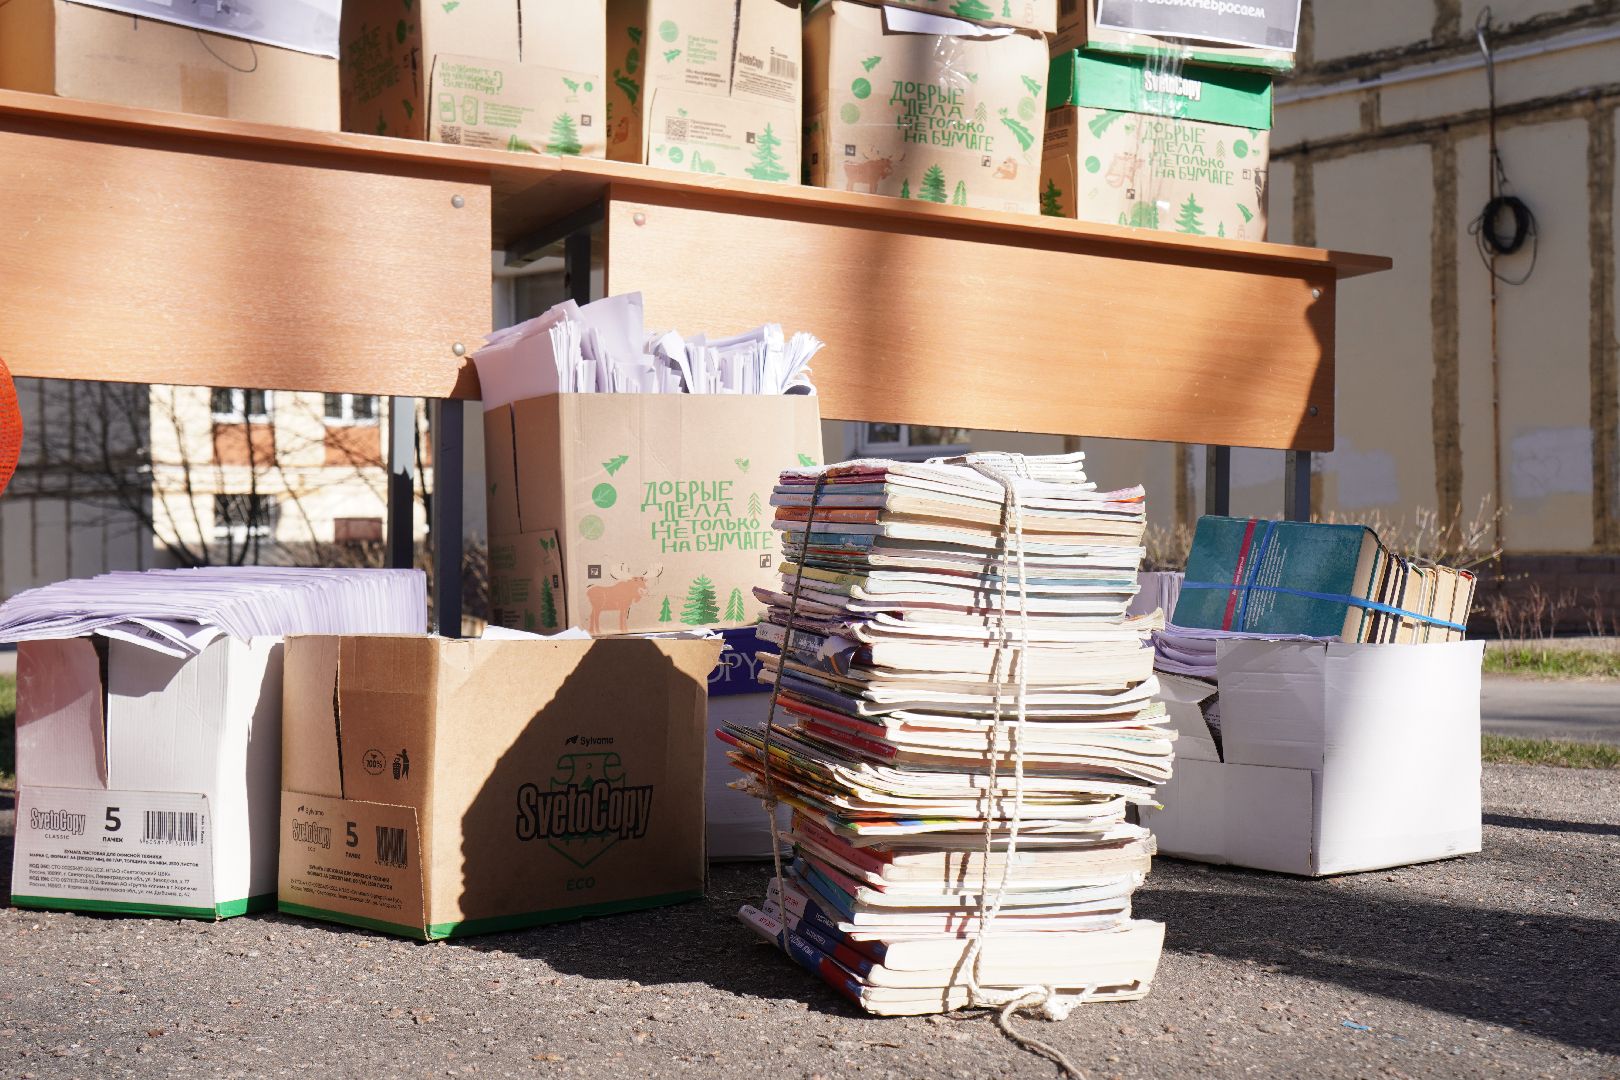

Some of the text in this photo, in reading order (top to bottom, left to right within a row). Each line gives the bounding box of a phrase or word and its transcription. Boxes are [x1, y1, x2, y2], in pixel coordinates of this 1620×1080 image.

[889, 81, 965, 108] ДОБРЫЕ
[905, 100, 964, 122] ДЕЛА
[929, 115, 985, 133] ТОЛЬКО
[1142, 121, 1206, 145] ДОБРЫЕ
[904, 131, 994, 152] НА БУМАГЕ
[1153, 138, 1204, 156] ДЕЛА
[1175, 154, 1225, 169] ТОЛЬКО
[1155, 167, 1234, 186] НА БУМАГЕ
[641, 480, 733, 513] ДОБРЫЕ
[661, 501, 732, 527] ДЕЛА
[652, 517, 760, 540] НЕ ТОЛЬКО
[661, 531, 773, 553] НА БУМАГЕ
[580, 736, 614, 748] Sylvamo
[30, 807, 86, 836] SvetoCopy
[104, 806, 121, 831] 5
[516, 779, 653, 841] SvetoCopy
[292, 818, 332, 850] SvetoCopy
[345, 821, 359, 848] 5
[566, 876, 596, 891] ECO
